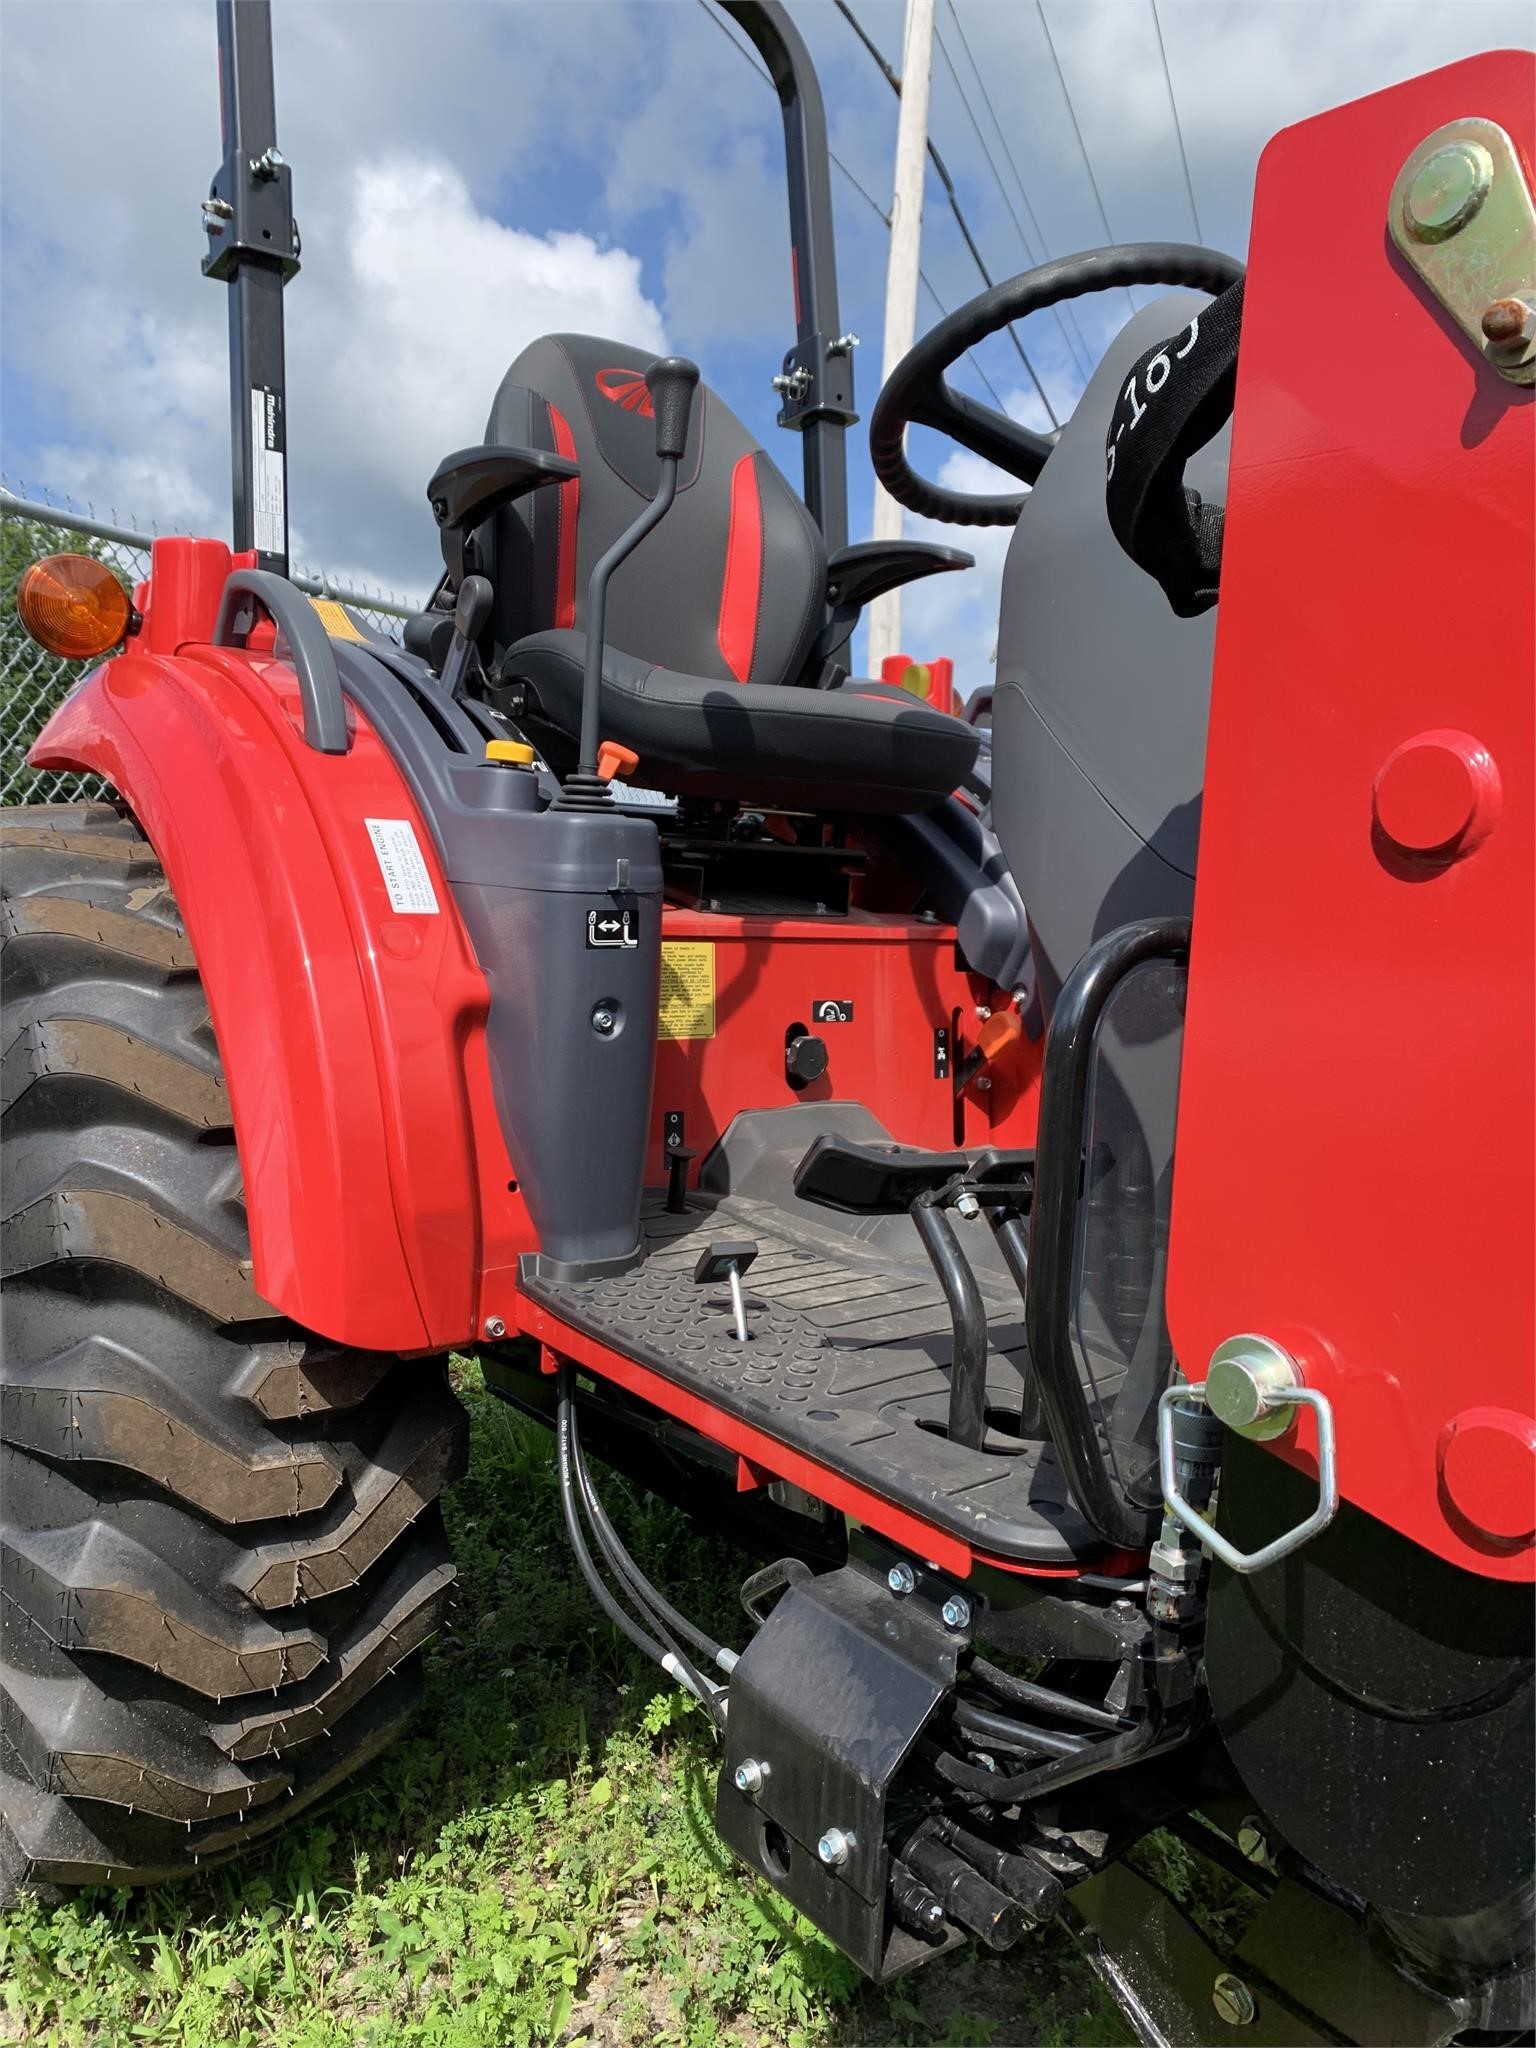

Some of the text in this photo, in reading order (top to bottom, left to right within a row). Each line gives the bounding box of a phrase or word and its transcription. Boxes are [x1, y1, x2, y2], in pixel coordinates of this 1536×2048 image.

[266, 394, 275, 448] Mahindra
[372, 824, 405, 906] TO START ENGINE
